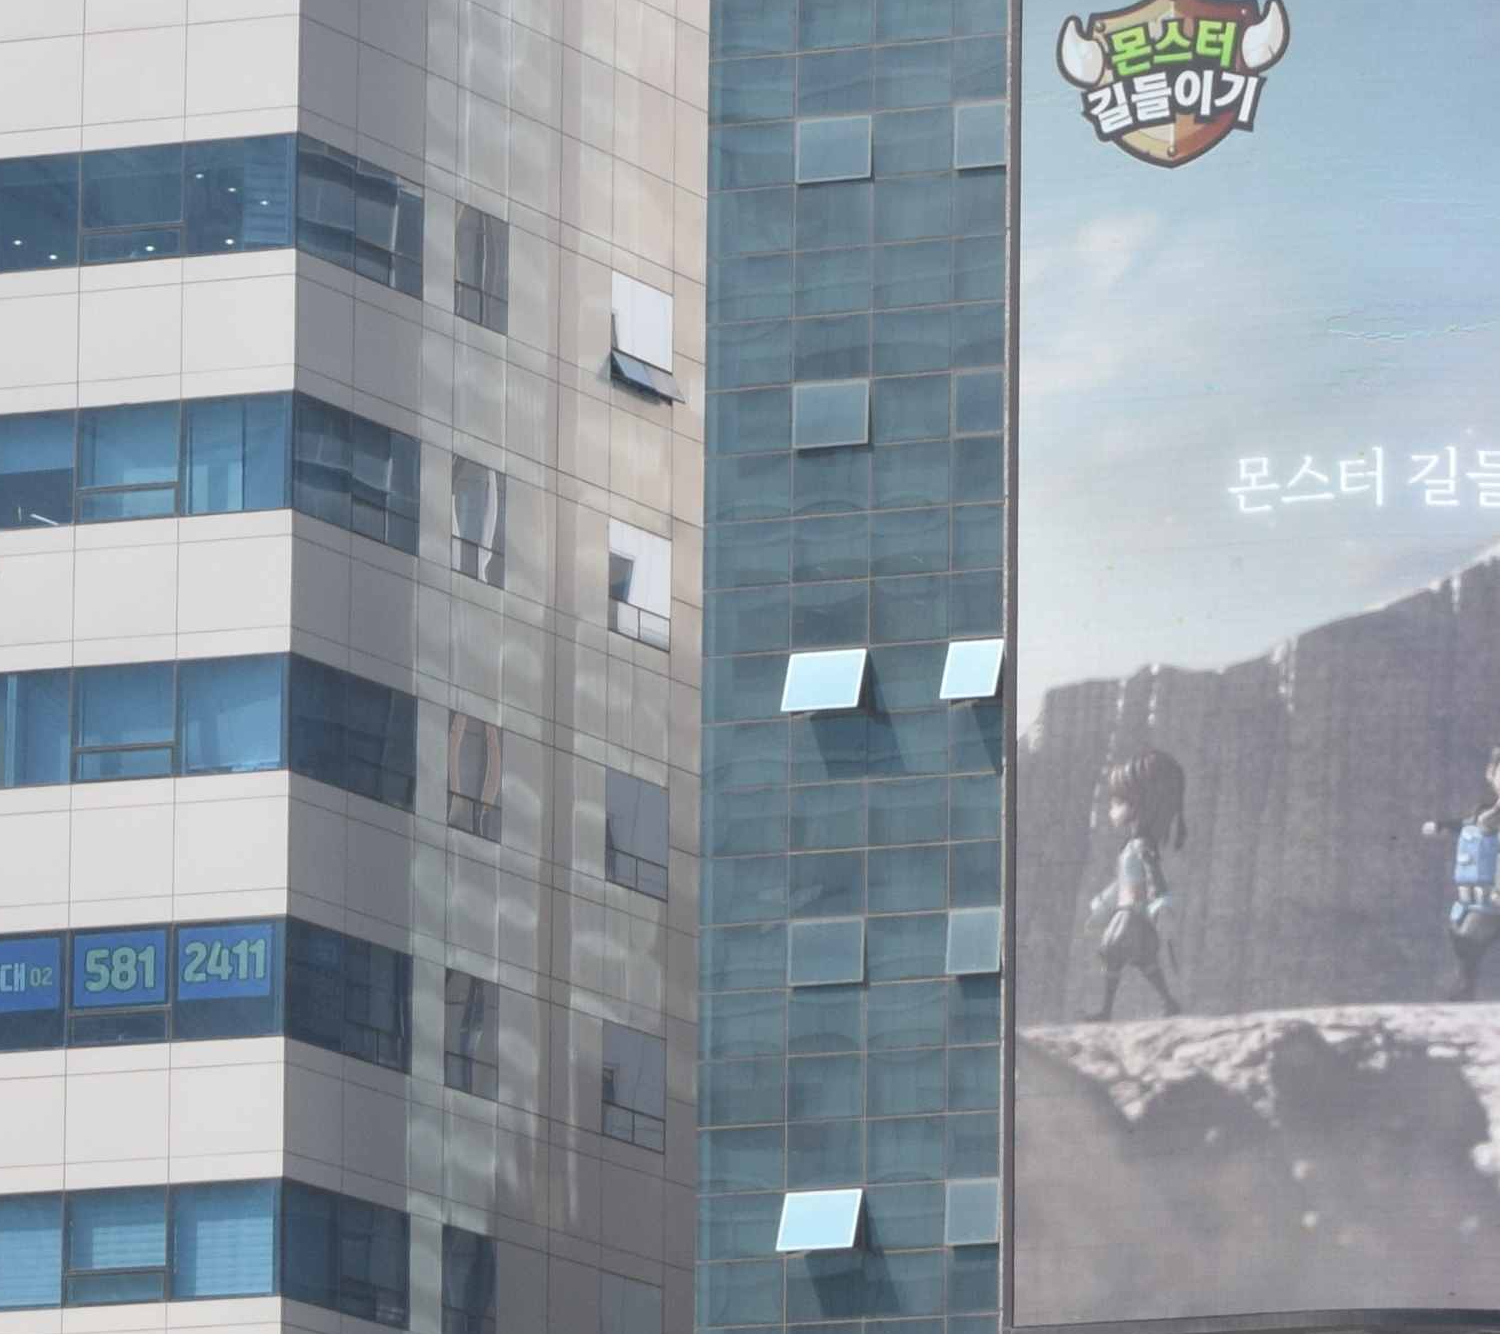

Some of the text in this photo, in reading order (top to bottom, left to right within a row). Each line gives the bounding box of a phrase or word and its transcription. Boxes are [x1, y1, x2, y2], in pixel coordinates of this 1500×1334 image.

[1110, 20, 1237, 76] 몬스터
[1087, 69, 1259, 134] 길들이기
[1227, 446, 1385, 514] 몬스터
[29, 966, 53, 987] 02
[84, 945, 157, 993] 581
[183, 937, 267, 984] 2411
